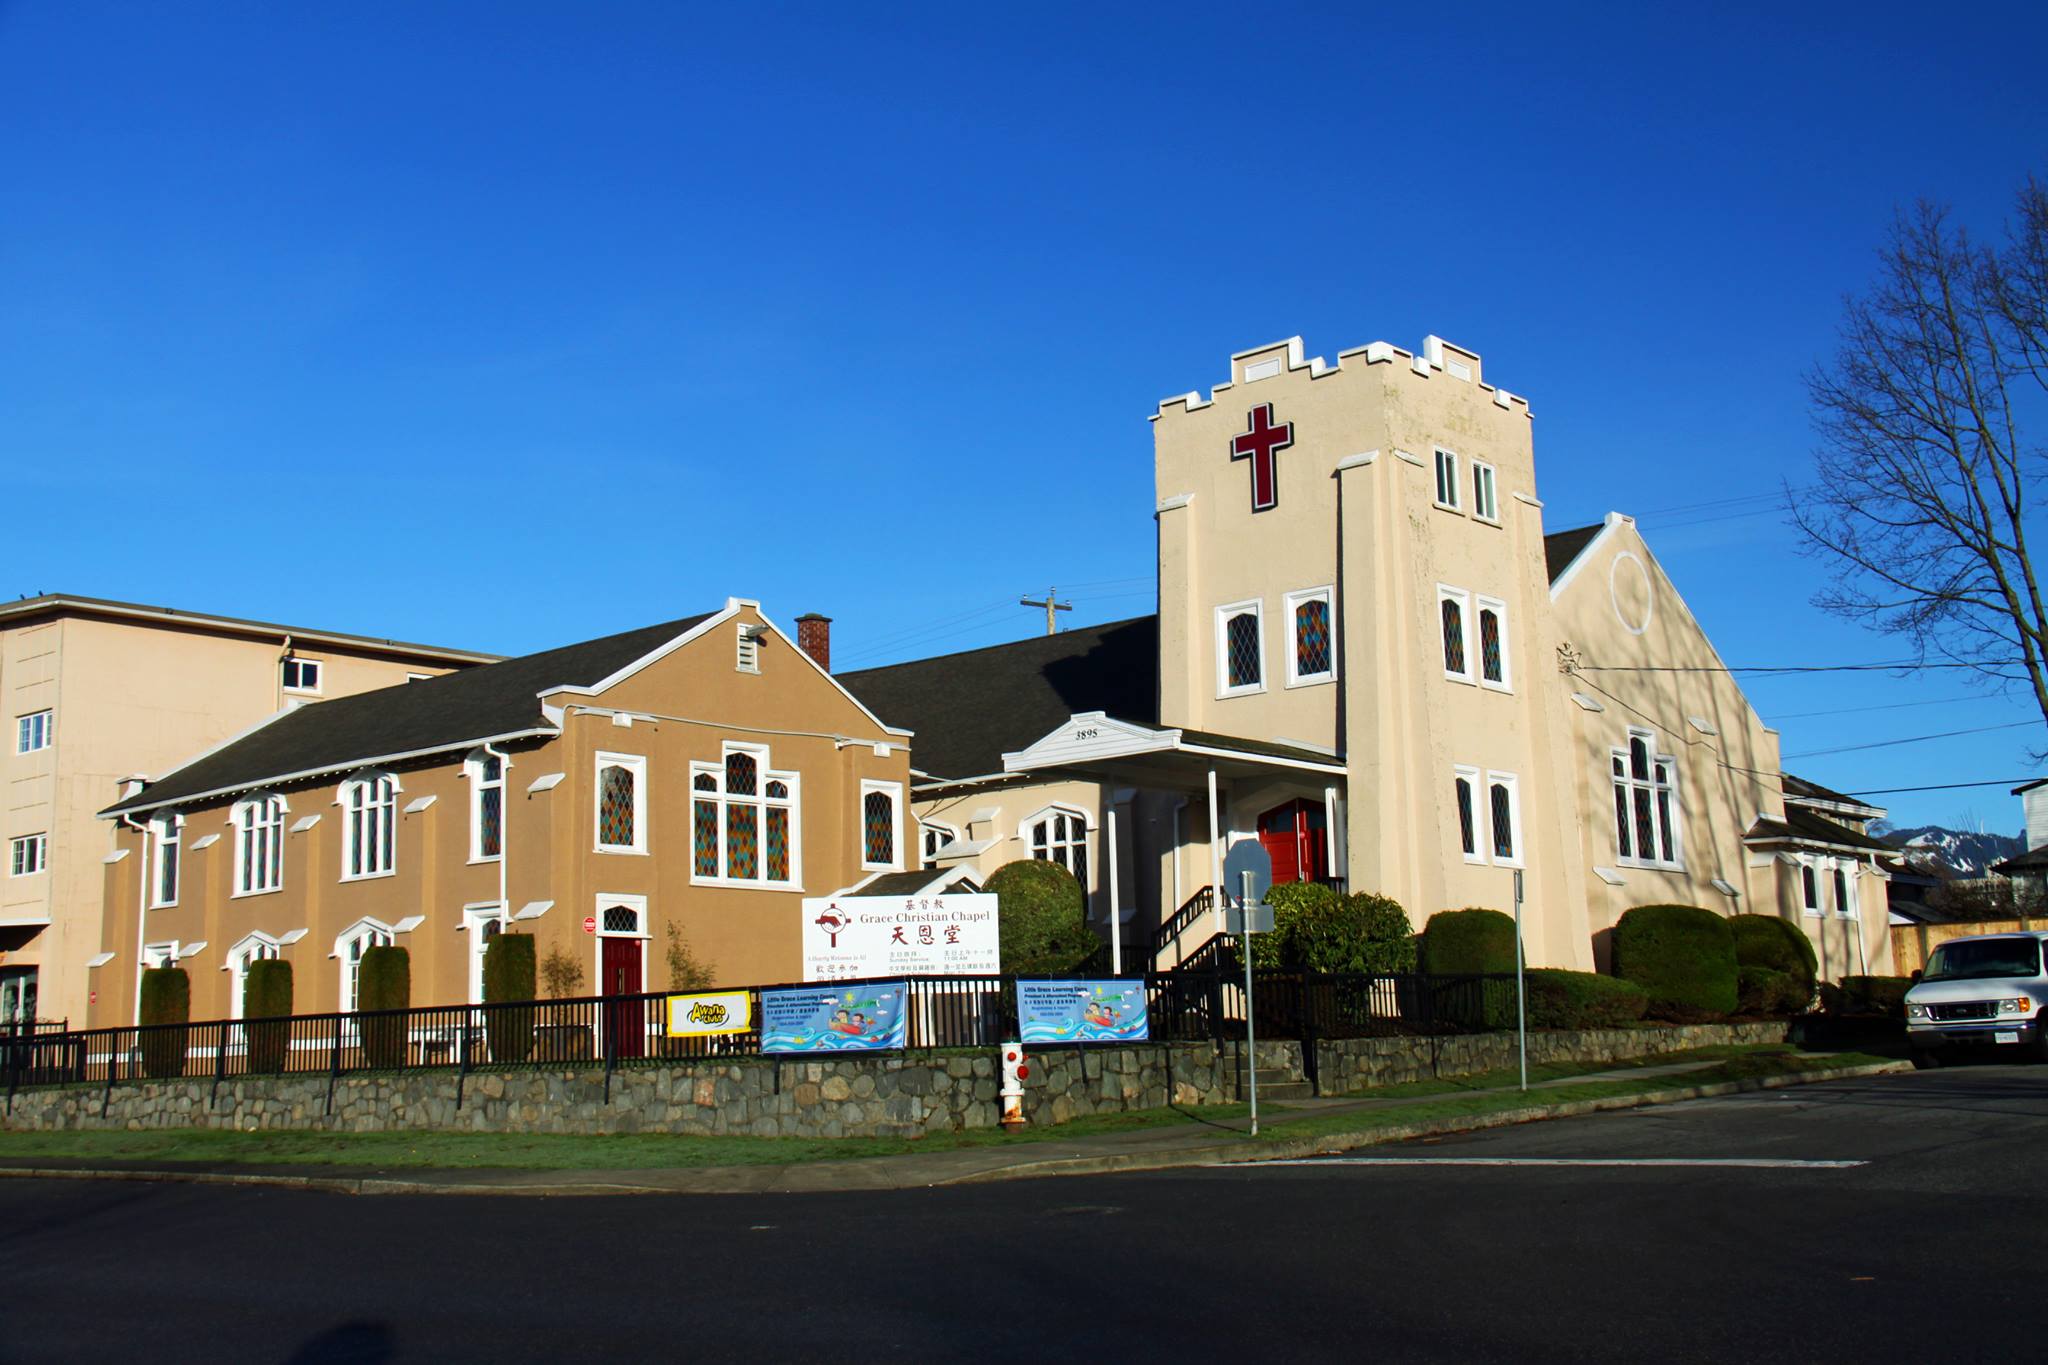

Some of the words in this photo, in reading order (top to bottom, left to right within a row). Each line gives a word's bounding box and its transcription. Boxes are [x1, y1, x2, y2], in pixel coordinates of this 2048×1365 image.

[1075, 729, 1097, 740] 3895
[905, 899, 944, 911] 基督教
[860, 913, 893, 924] Grace
[896, 911, 948, 923] Christian
[951, 910, 990, 922] Chapel
[891, 924, 961, 945] 天恩堂
[690, 1001, 726, 1023] Awana
[703, 1010, 724, 1024] Clubs
